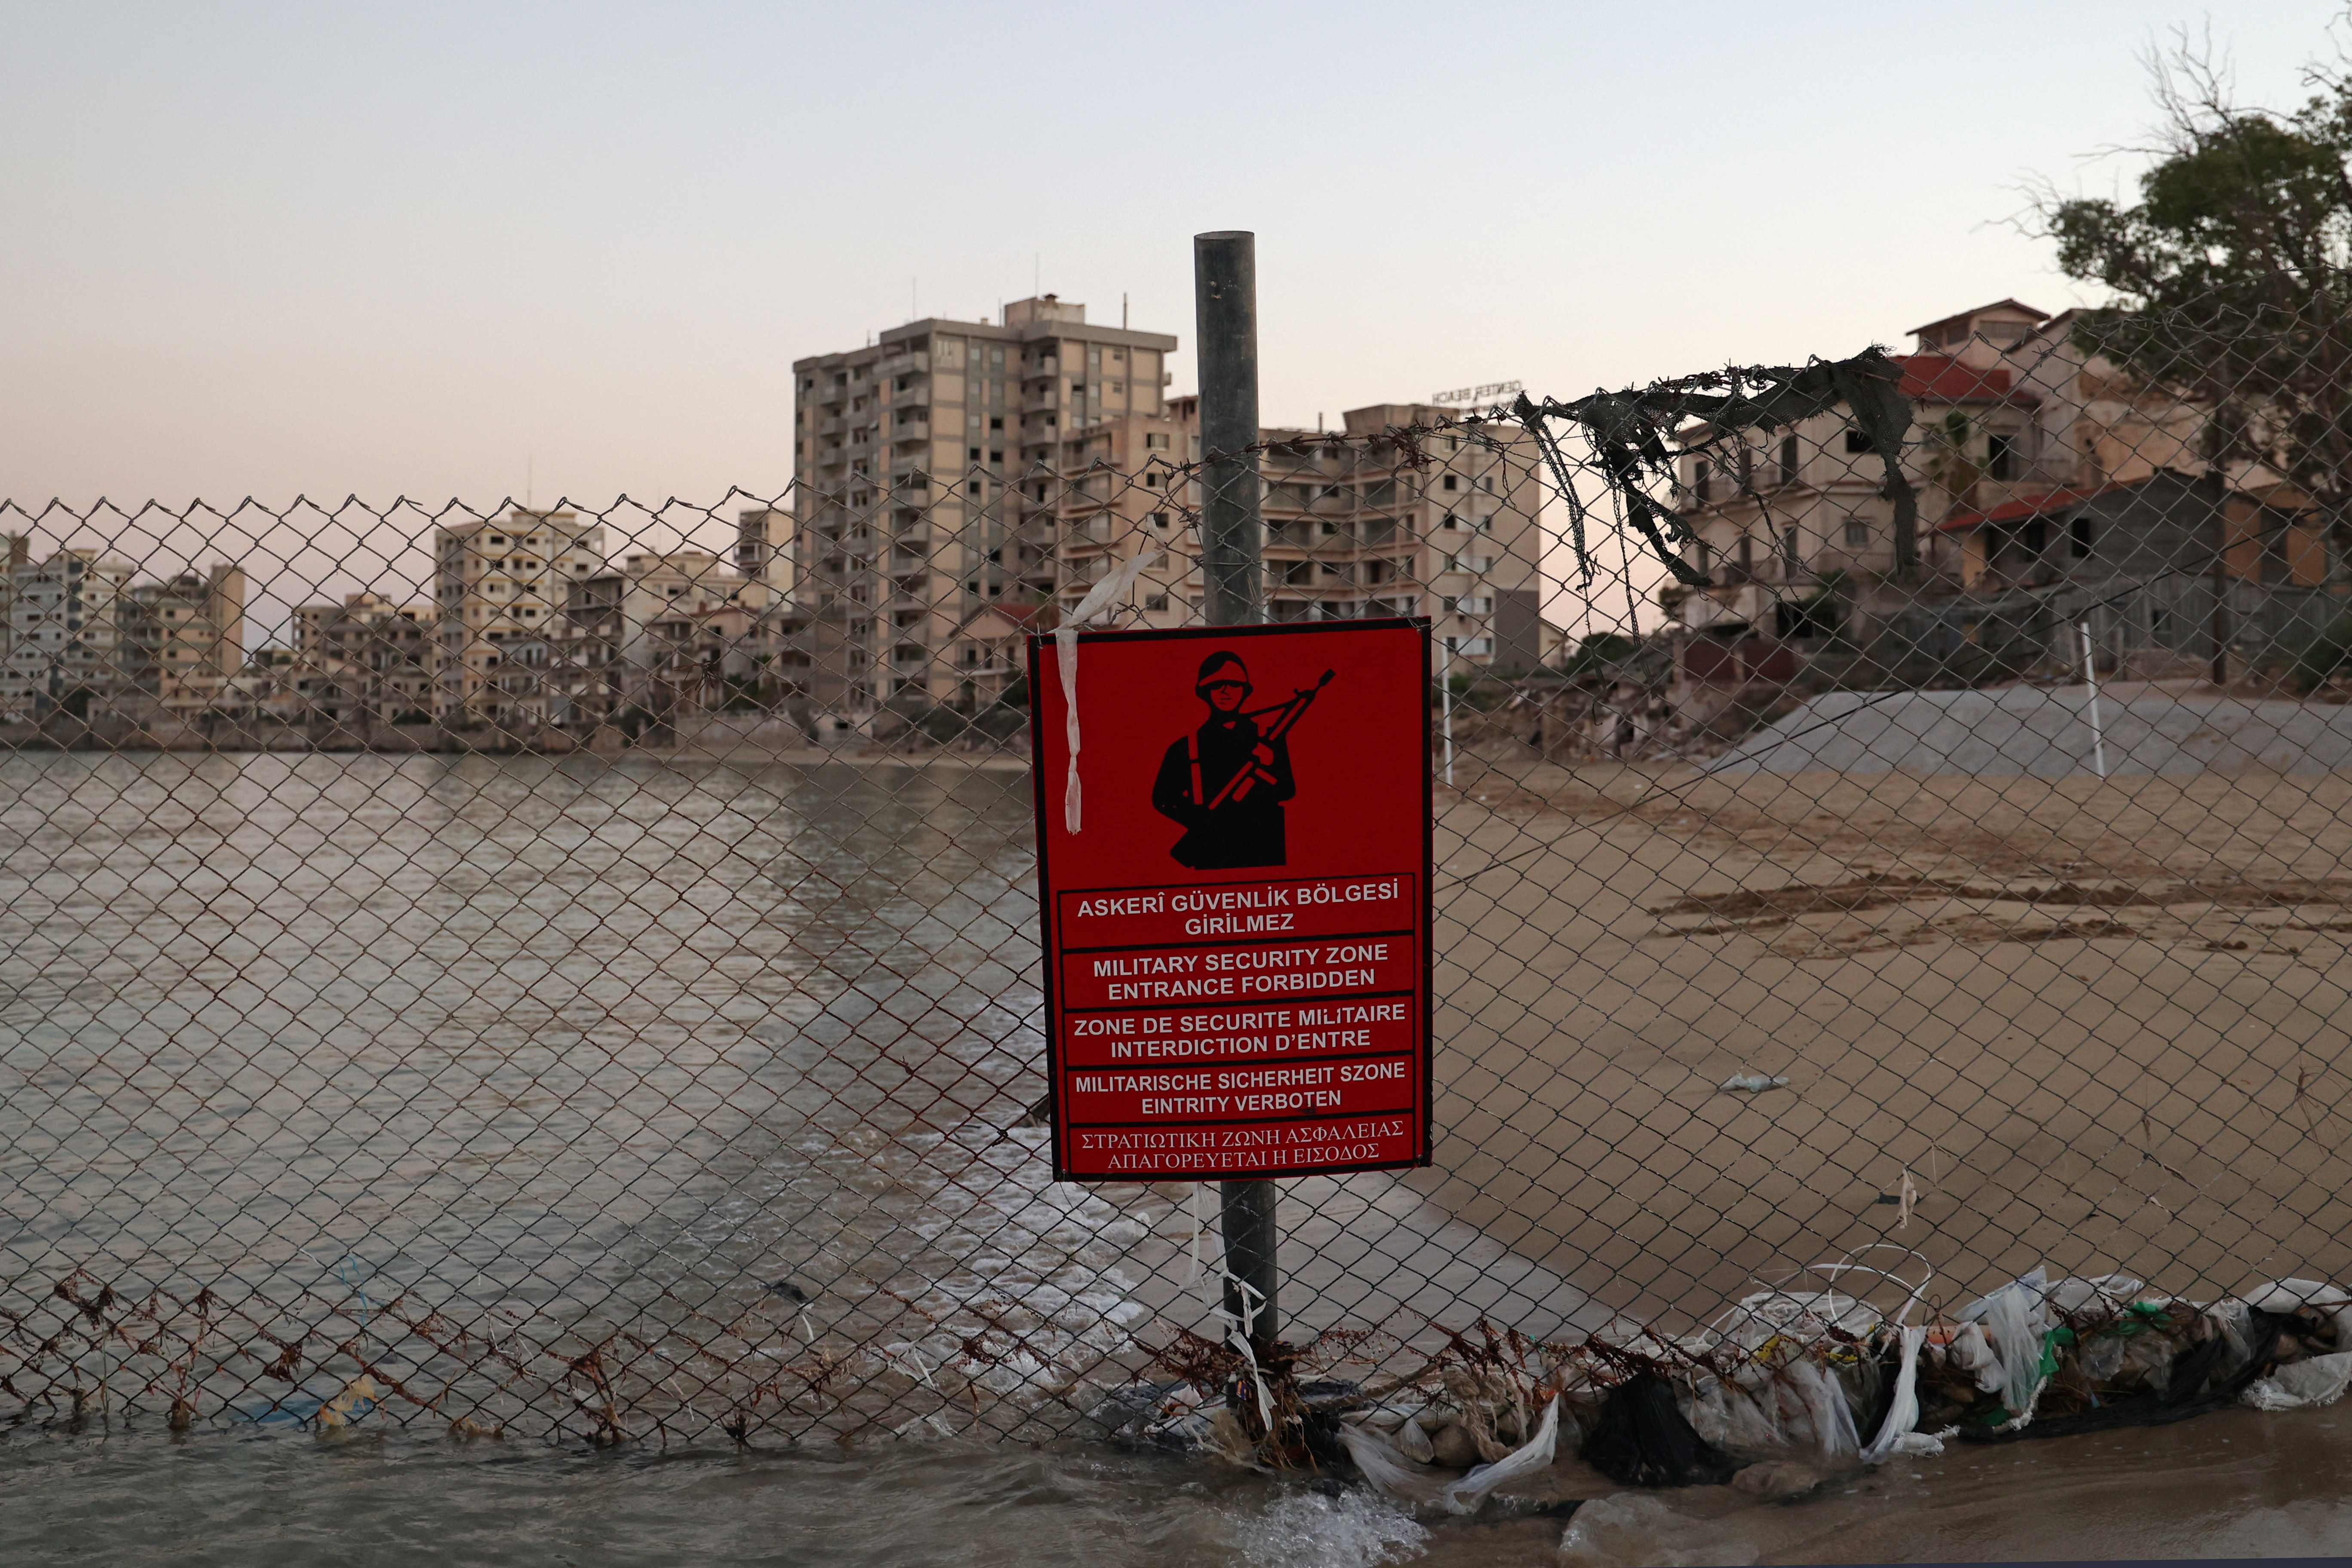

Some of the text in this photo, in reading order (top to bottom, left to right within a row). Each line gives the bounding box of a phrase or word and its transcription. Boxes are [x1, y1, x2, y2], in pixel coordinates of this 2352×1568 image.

[1172, 886, 1290, 912] GÜVENLİK
[1297, 878, 1398, 905] BÖLGESİ
[1185, 913, 1294, 935] GİRİLMEZ
[1094, 944, 1388, 977] MILITARY SECURITY ZONE
[1109, 968, 1374, 1000] ENTRANCE FORBIDDEN
[1074, 1018, 1135, 1036] ZONE
[1143, 1017, 1173, 1034] DE
[1180, 1011, 1291, 1032] SECURITE
[1112, 1036, 1267, 1058] INTERDICTION
[1076, 1062, 1405, 1092] MILITARISCHE SICHERHEIT SZONE
[1142, 1090, 1341, 1114] EINTRITY VERBOTEN
[1081, 1121, 1403, 1148] ΣΤΡΑΤΙΩΤΙΚΗ ΖΩΝΗ ΑΣΦΑΛΕΙΑΣ
[1108, 1143, 1379, 1168] ΑΠΑΓΟΡΕΥΕΤΑΙ Η ΕΙΣΟΔΟΣ
